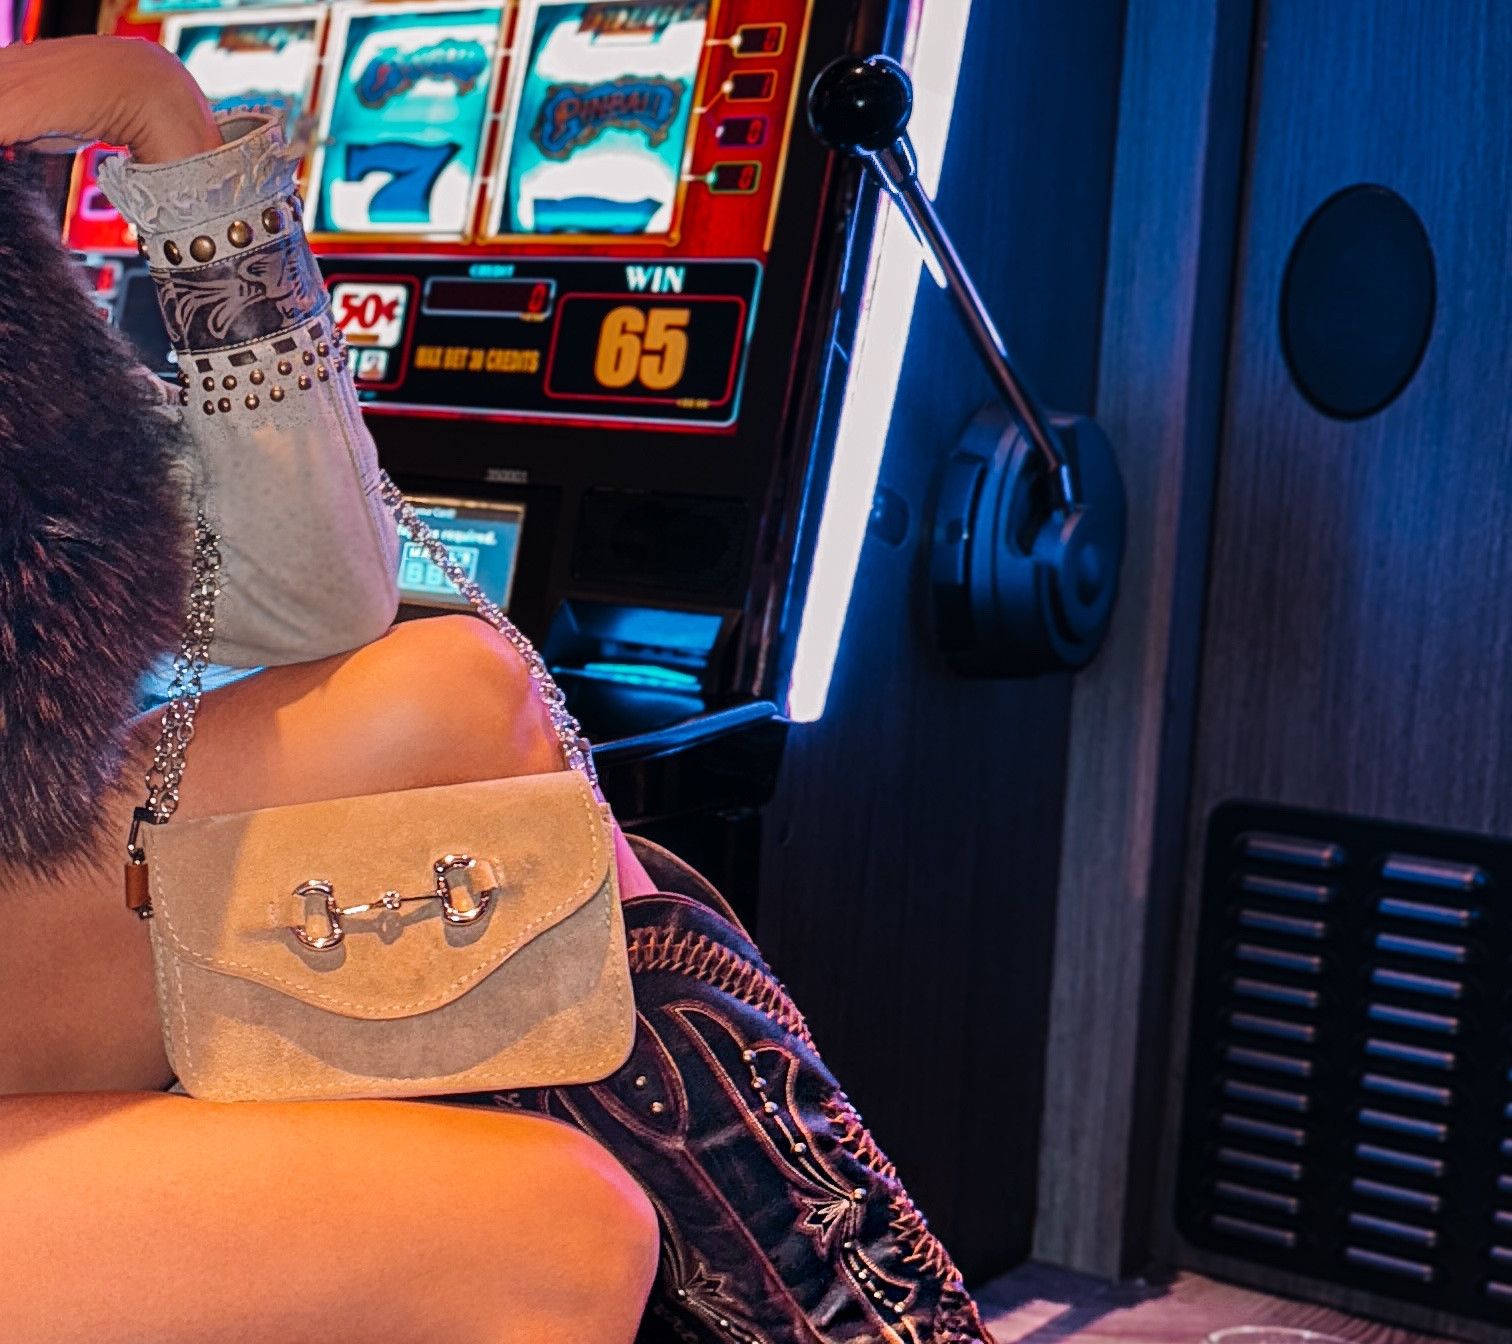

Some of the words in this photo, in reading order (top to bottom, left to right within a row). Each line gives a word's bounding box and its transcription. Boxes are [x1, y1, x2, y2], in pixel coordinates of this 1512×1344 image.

[747, 119, 763, 144] 0
[739, 165, 754, 189] 0
[626, 265, 686, 294] WIN
[528, 283, 547, 313] 0
[485, 348, 540, 375] CREDITS
[594, 306, 691, 391] 65
